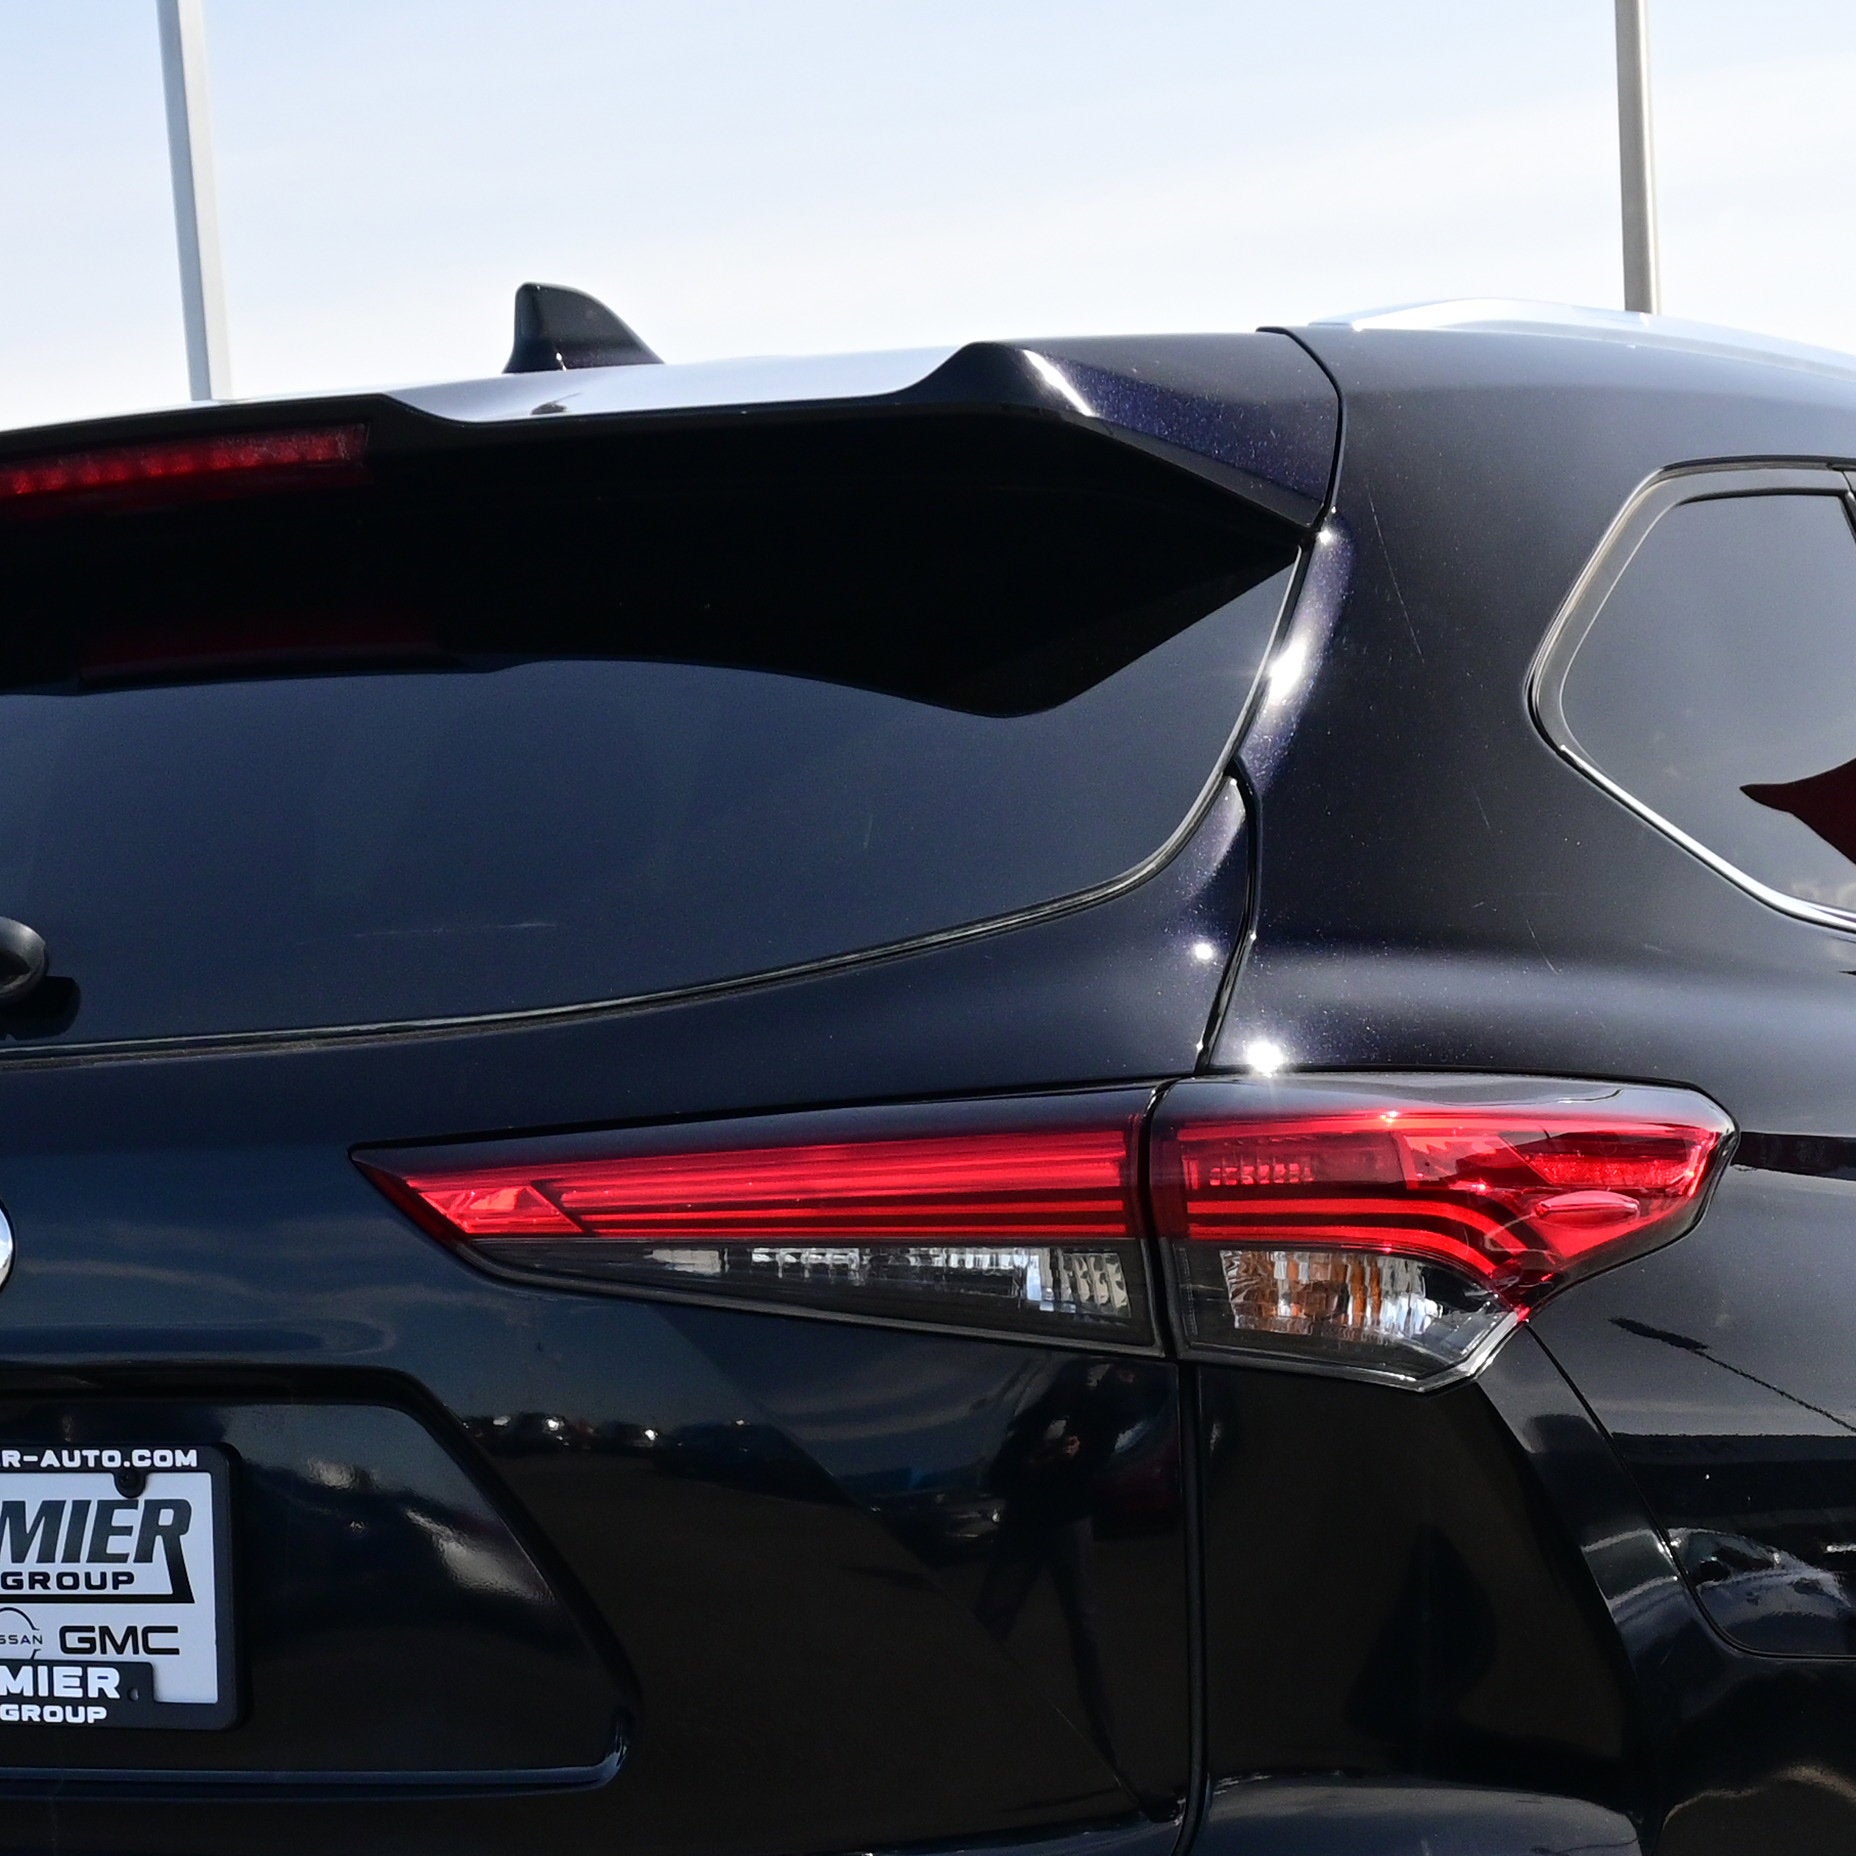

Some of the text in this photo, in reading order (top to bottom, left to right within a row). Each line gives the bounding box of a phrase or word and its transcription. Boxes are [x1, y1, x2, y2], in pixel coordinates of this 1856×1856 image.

[0, 1572, 135, 1590] GROUP
[58, 1625, 181, 1655] GMC
[0, 1703, 108, 1724] GROUP
